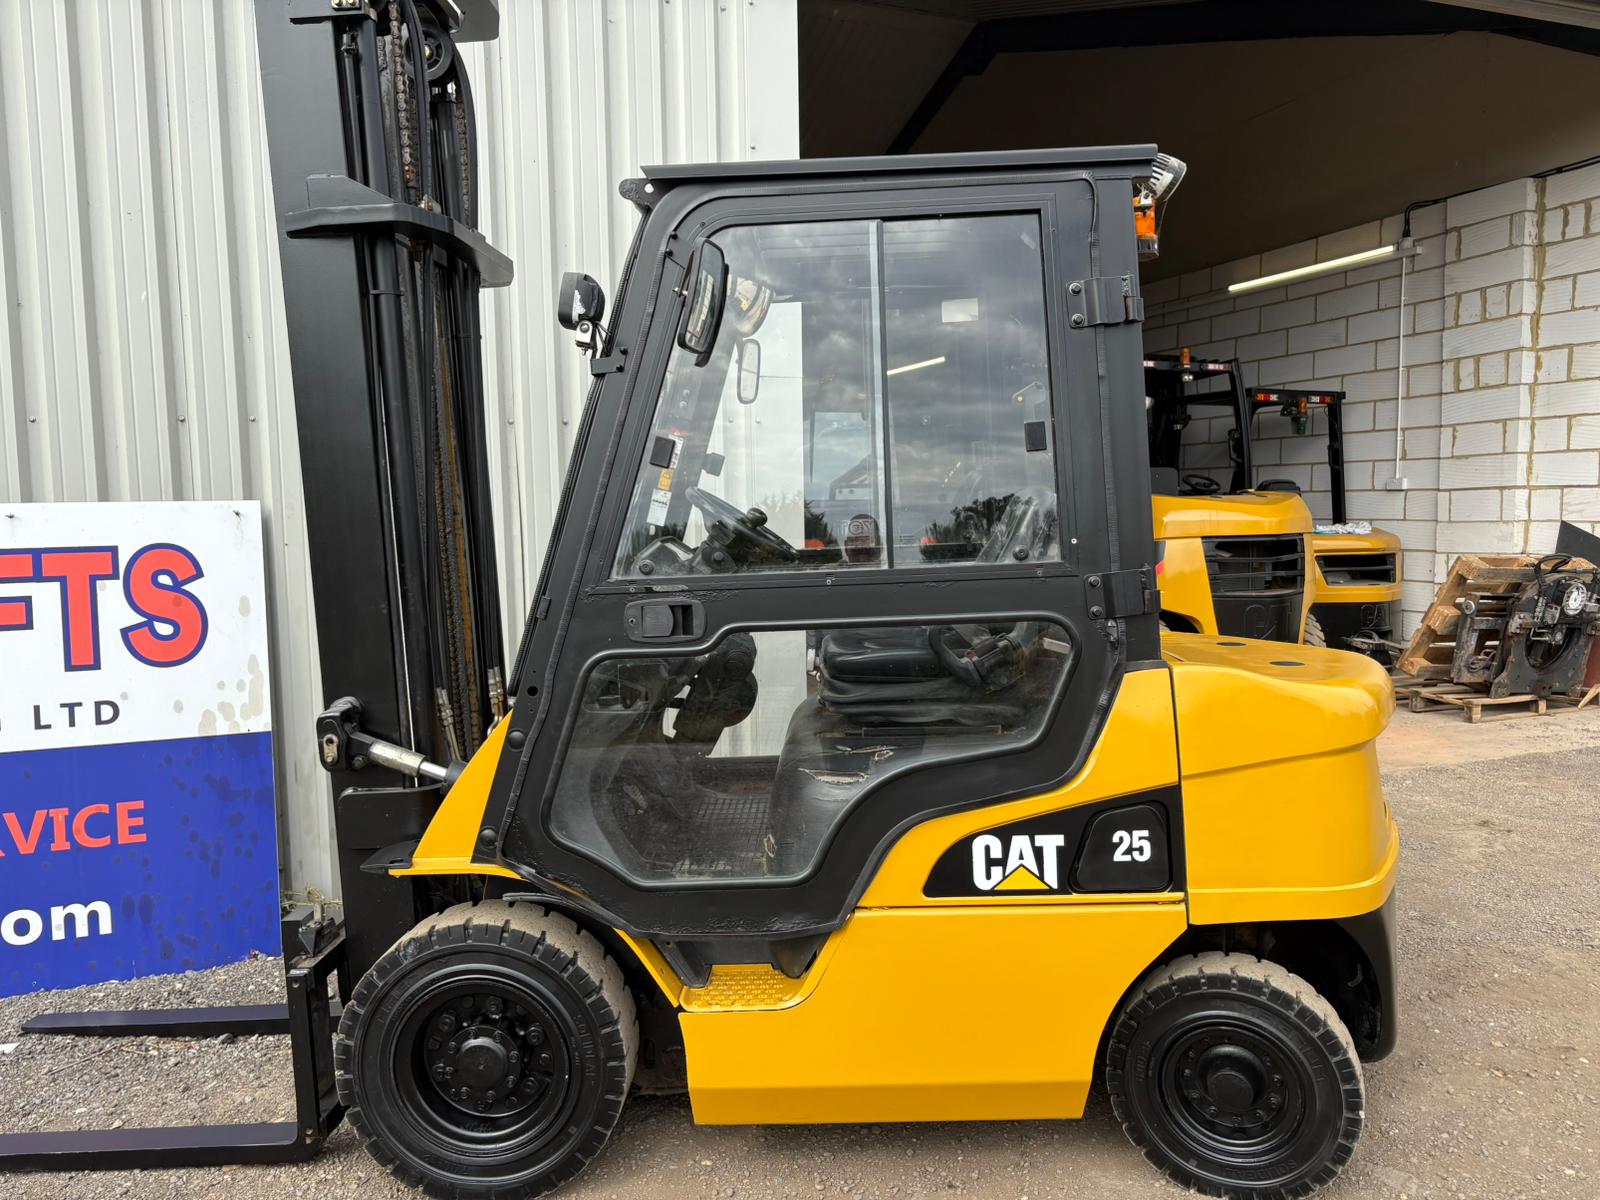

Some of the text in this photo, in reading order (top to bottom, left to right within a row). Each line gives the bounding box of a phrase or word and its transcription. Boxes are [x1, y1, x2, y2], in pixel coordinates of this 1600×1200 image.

[33, 699, 120, 731] LTD
[0, 800, 147, 857] VICE
[1111, 829, 1152, 863] 25
[971, 833, 1065, 891] CAT
